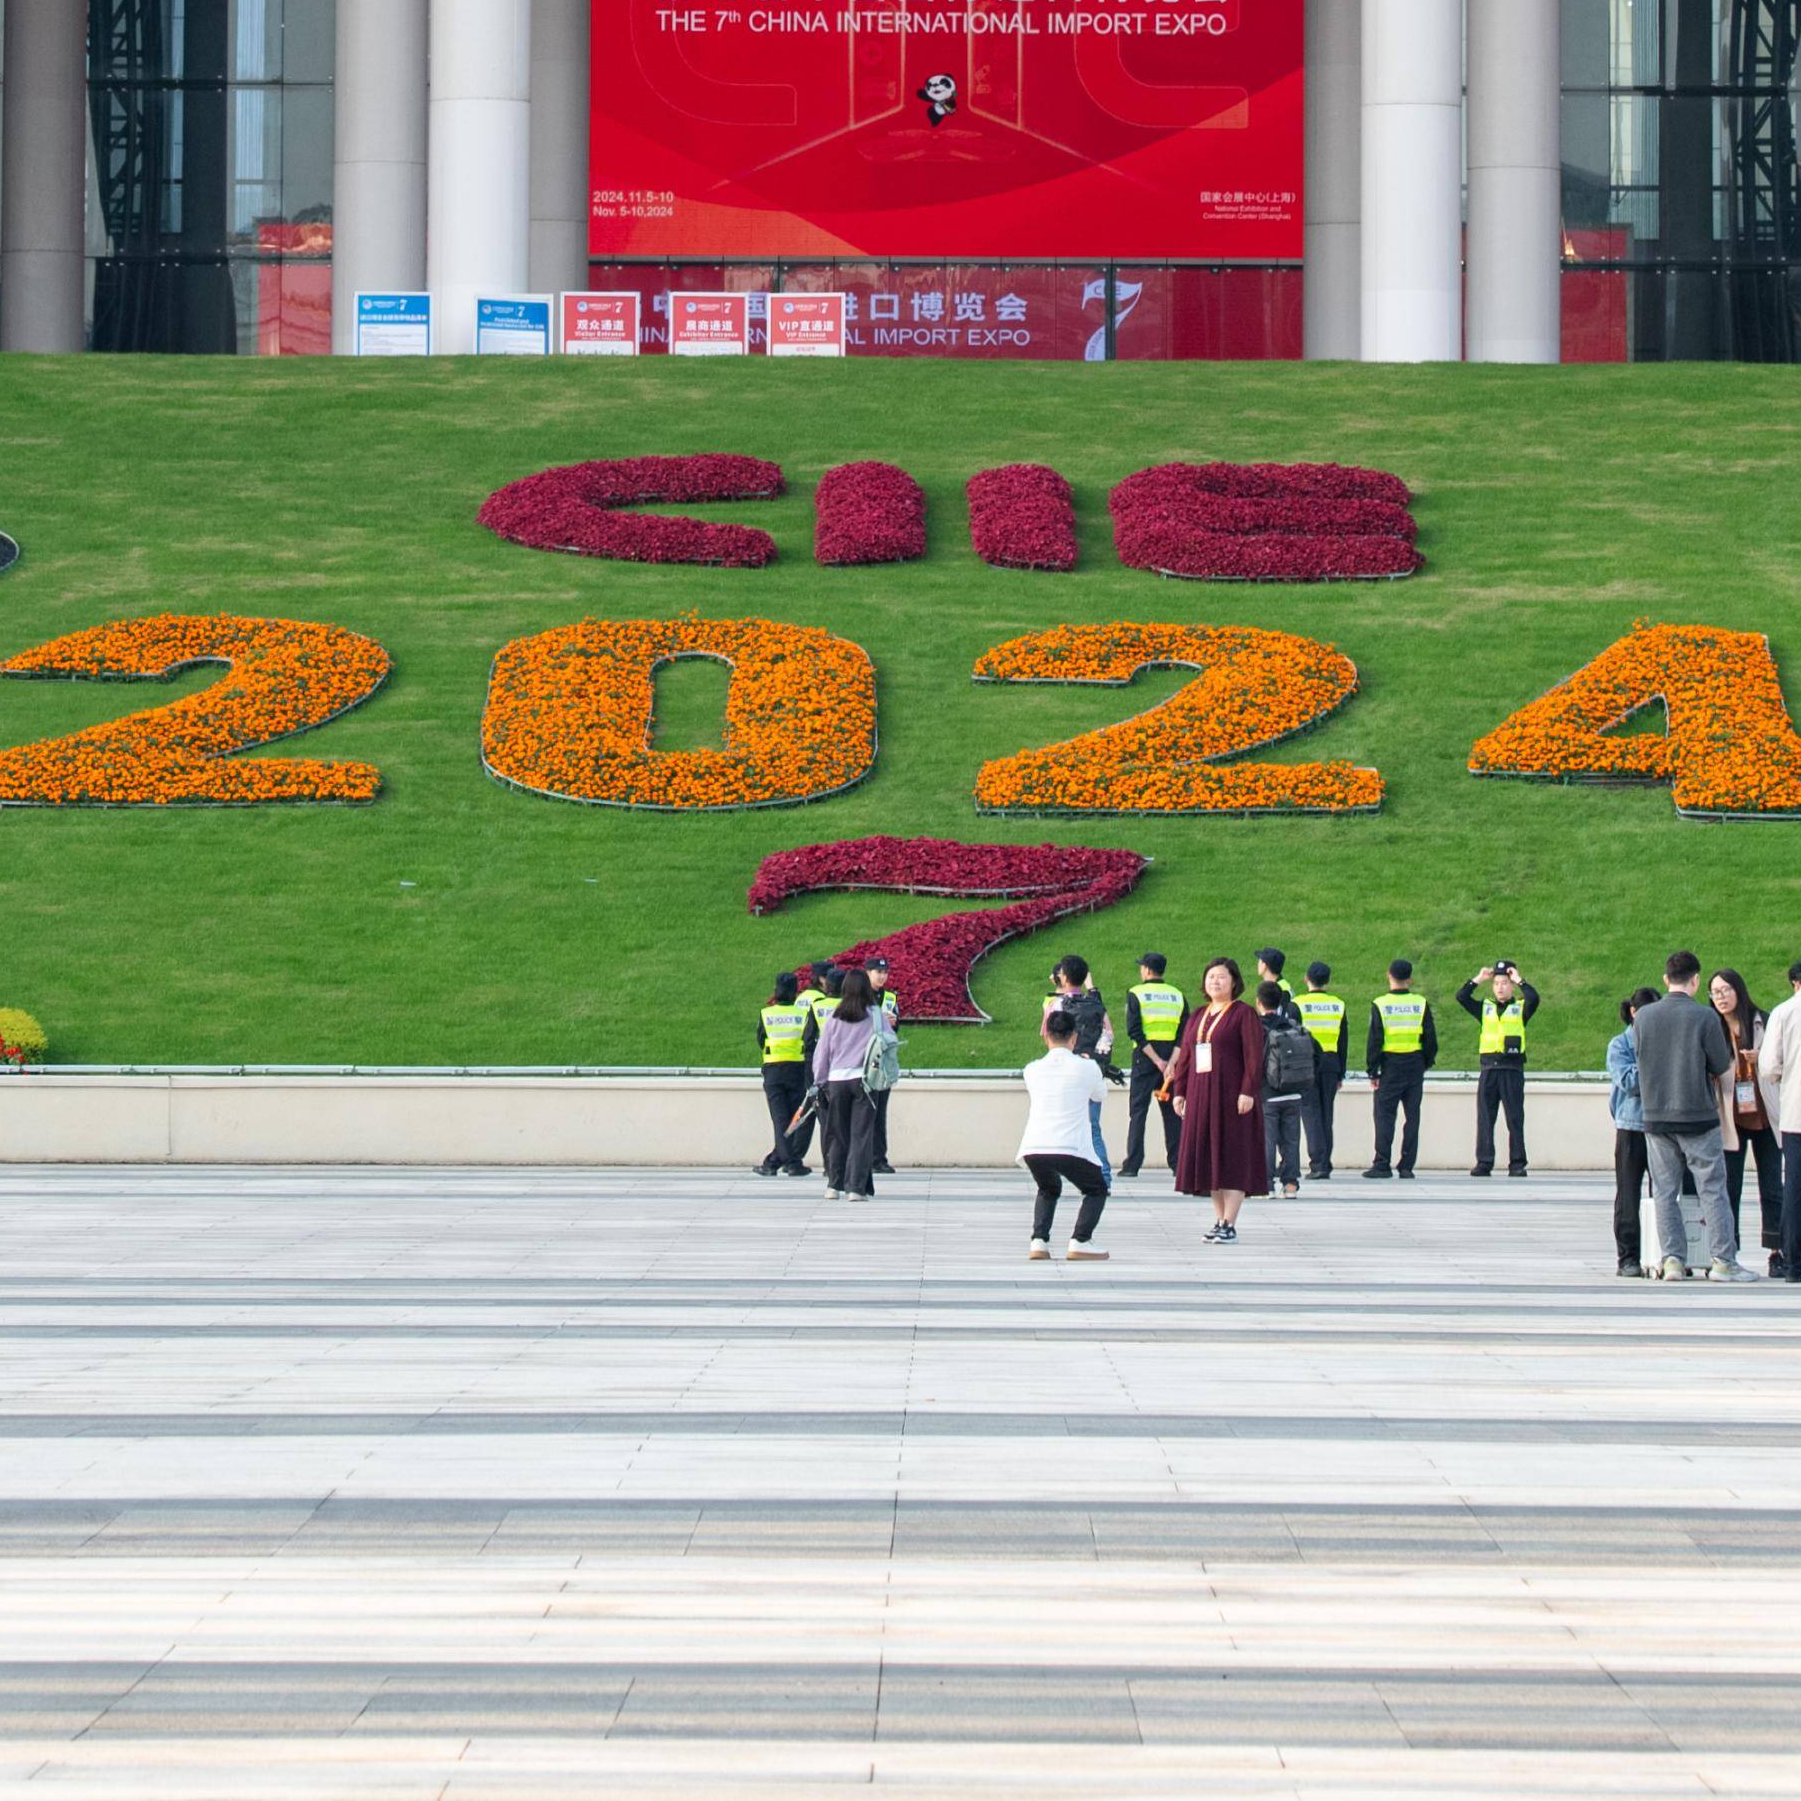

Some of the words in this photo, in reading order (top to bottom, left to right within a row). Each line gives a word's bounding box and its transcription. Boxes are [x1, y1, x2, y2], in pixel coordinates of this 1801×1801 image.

[655, 10, 706, 32] THE
[715, 10, 741, 32] 7th
[748, 10, 829, 33] CHINA
[836, 11, 1040, 34] INTERNATIONAL
[1048, 12, 1147, 35] IMPORT
[1154, 12, 1227, 36] EXPO
[593, 191, 674, 203] 2024.11.5-10
[593, 206, 617, 217] Nov.
[576, 319, 624, 331] 观众通道
[874, 328, 959, 346] IMPORT
[968, 329, 1031, 347] EXPO
[475, 451, 1427, 583] CIIE
[746, 834, 1156, 1024] 7
